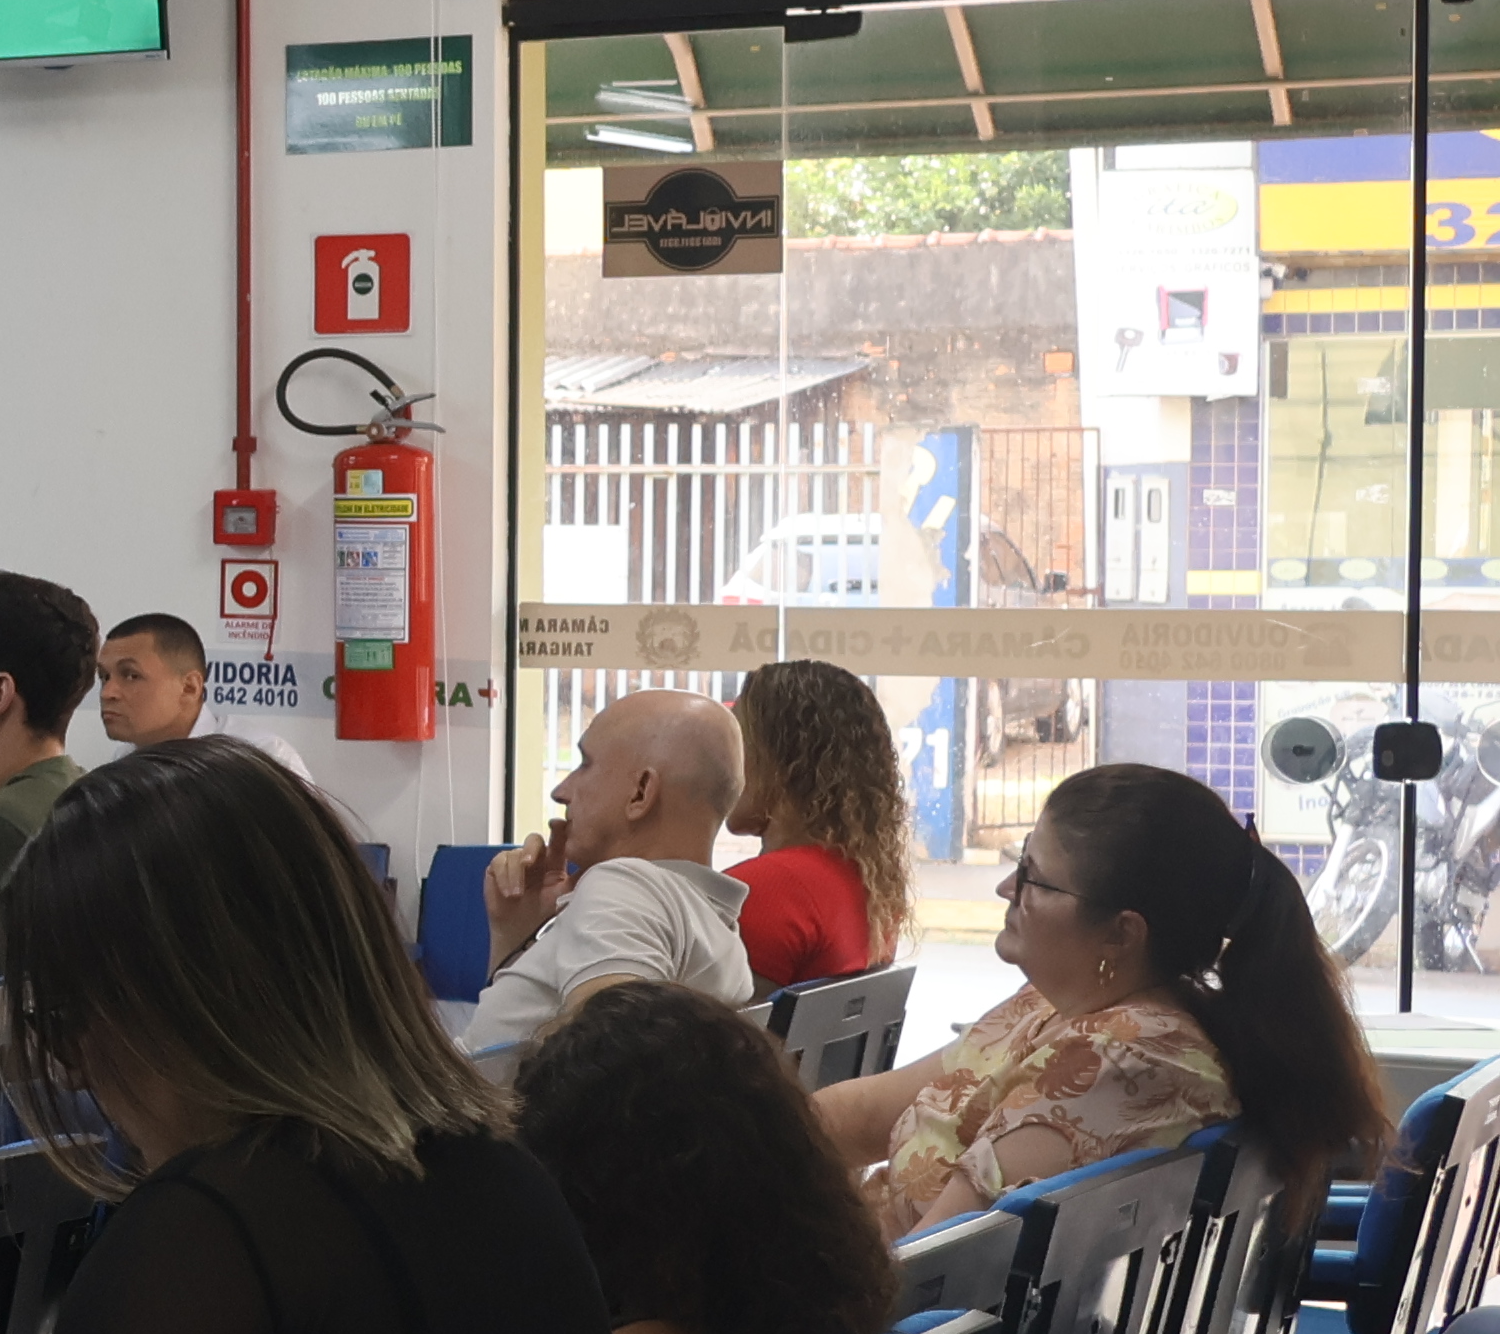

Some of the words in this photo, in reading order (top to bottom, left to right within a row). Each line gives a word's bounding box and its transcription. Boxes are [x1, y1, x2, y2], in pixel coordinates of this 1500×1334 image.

[317, 92, 336, 106] 100
[338, 89, 385, 105] PESSOAS
[224, 620, 259, 630] ALARME
[213, 686, 247, 705] 642
[253, 687, 298, 707] 4010
